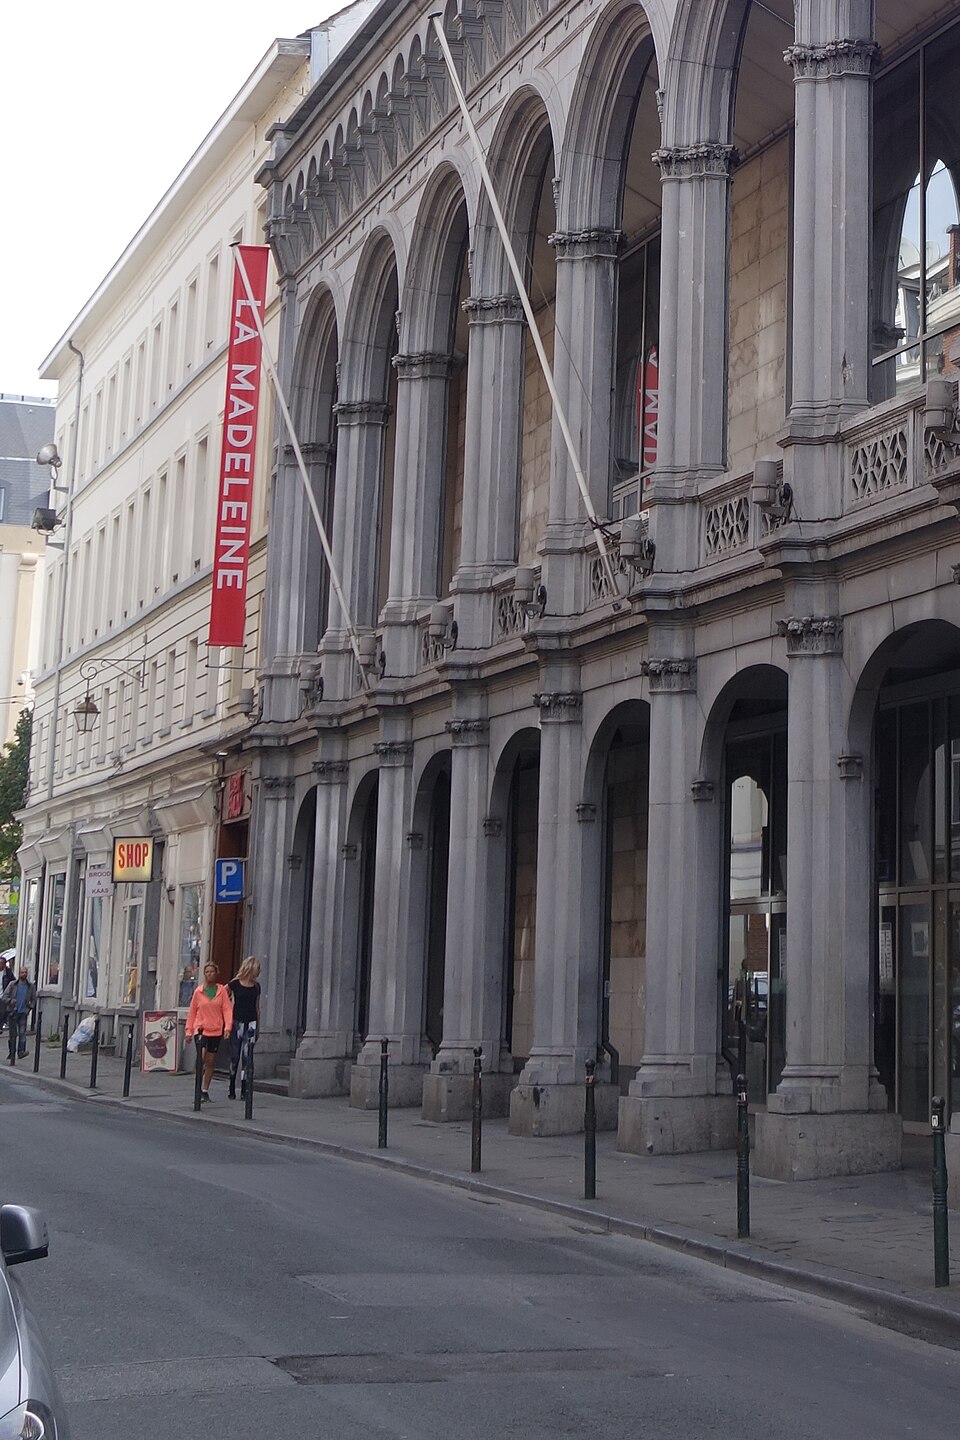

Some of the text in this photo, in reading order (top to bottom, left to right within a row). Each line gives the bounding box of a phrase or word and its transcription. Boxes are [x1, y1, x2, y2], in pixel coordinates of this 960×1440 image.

[217, 299, 261, 589] LA MADELEINE
[118, 843, 149, 868] SHOP
[221, 862, 237, 886] P
